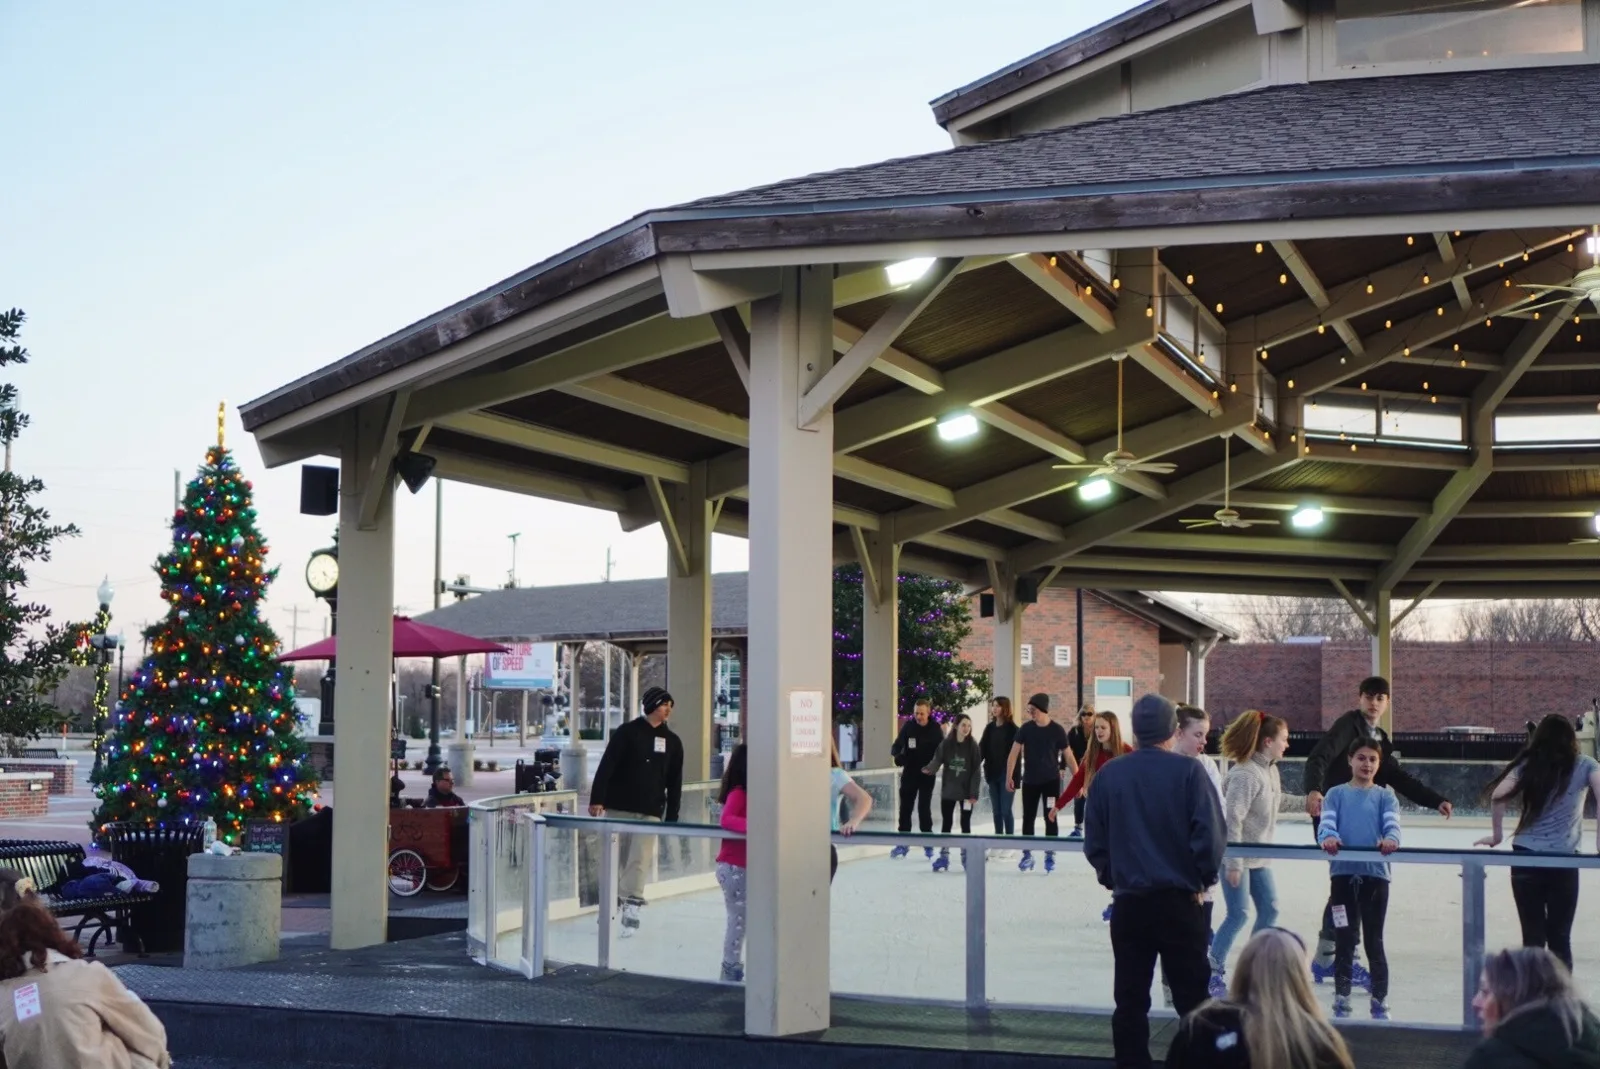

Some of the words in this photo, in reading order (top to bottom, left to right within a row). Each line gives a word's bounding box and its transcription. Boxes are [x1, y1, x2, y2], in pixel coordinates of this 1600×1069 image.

[493, 657, 501, 670] OF
[502, 657, 524, 670] SPEED
[800, 699, 813, 708] NO
[792, 714, 821, 722] PARKING
